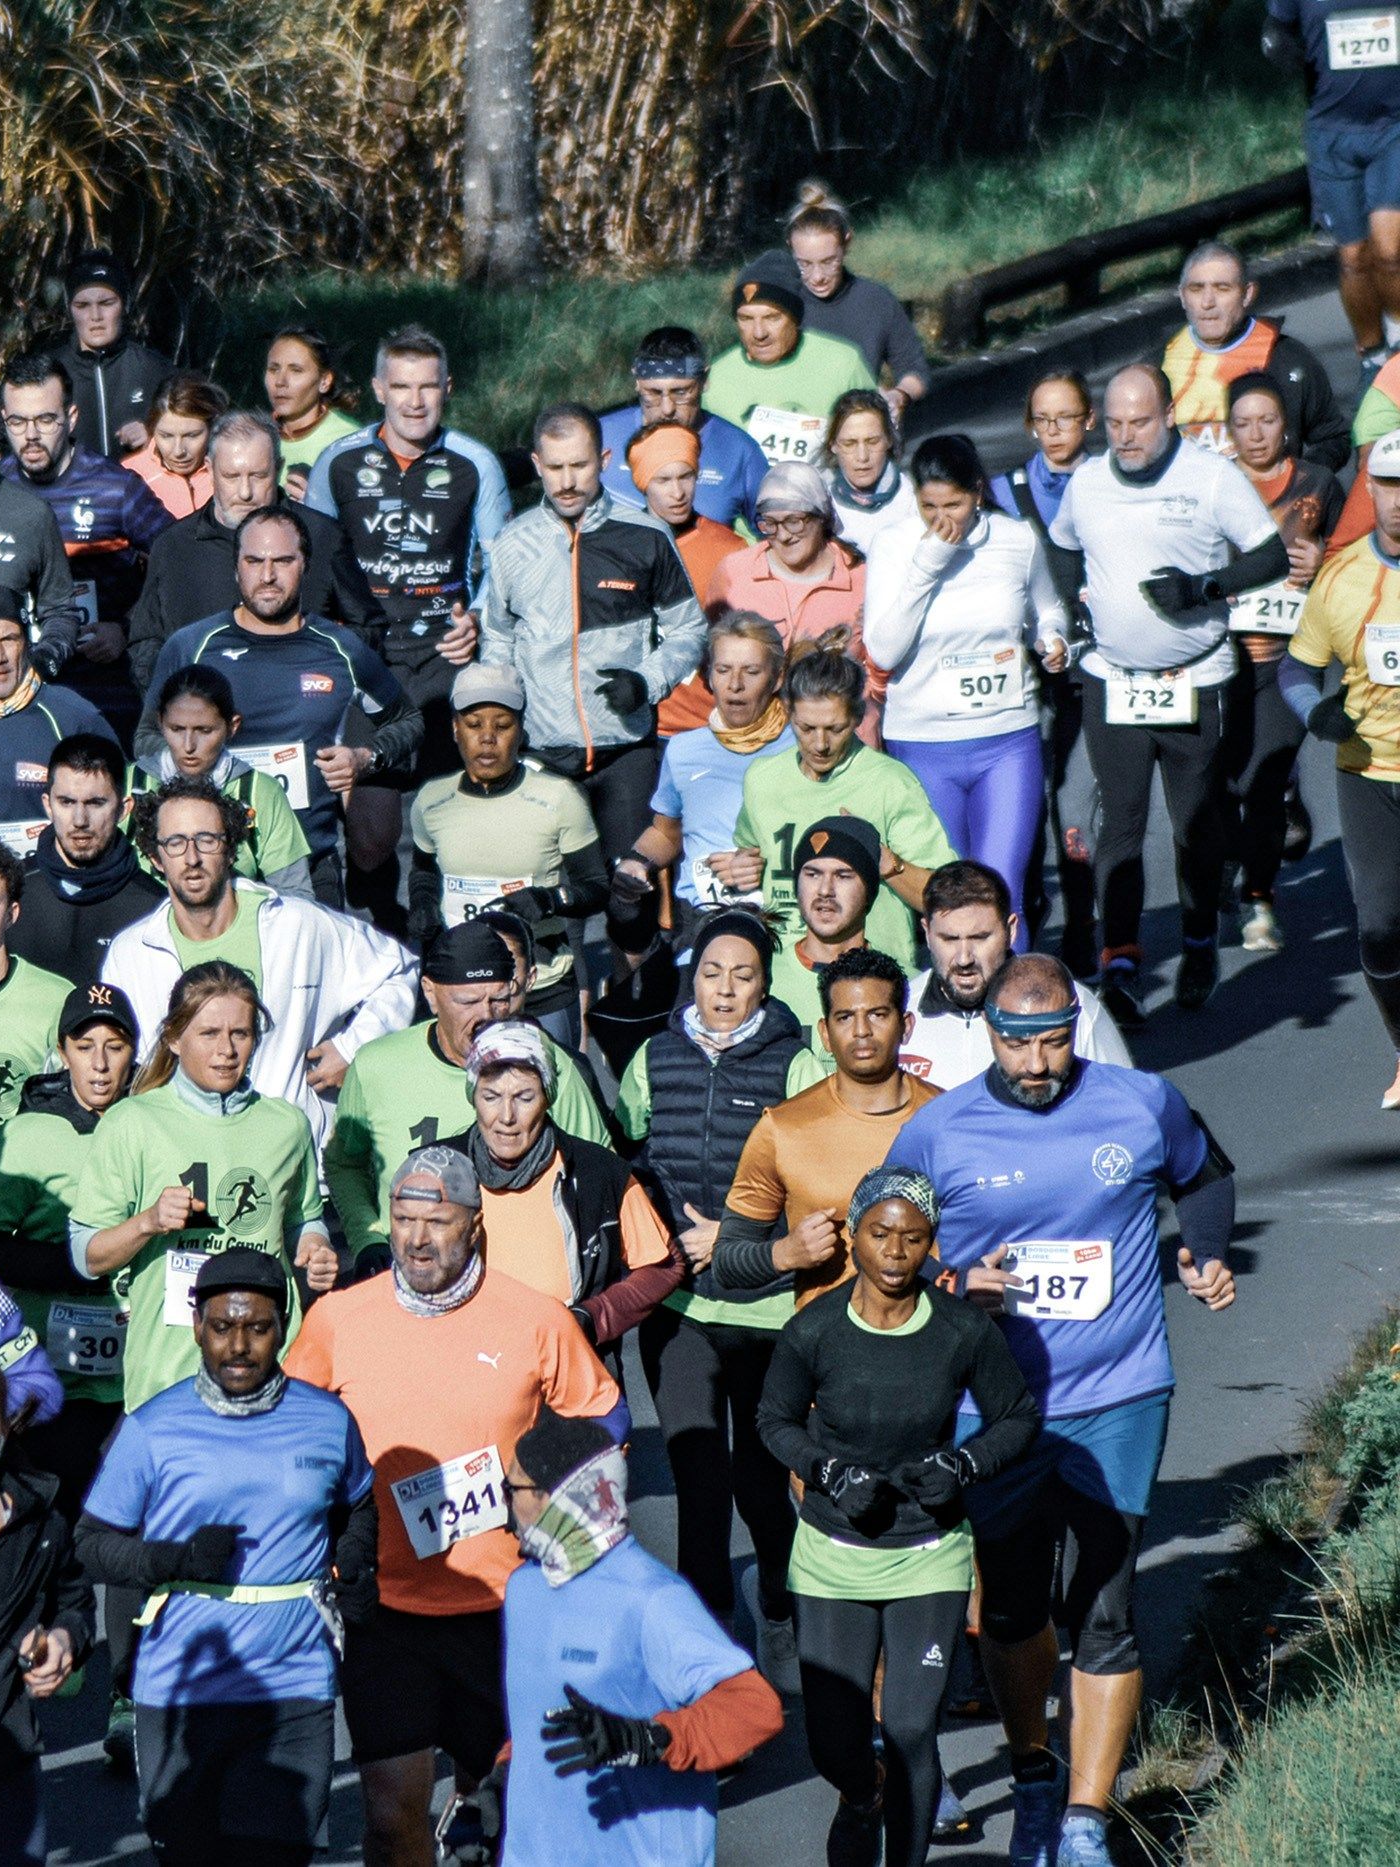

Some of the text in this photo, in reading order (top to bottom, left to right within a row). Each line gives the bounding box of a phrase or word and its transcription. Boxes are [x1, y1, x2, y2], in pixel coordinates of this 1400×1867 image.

[1339, 37, 1389, 56] 1270
[761, 434, 807, 457] 418
[421, 608, 453, 617] BERGERA
[302, 679, 332, 691] SNCF
[960, 673, 1007, 697] 507
[1125, 689, 1174, 708] 732
[19, 769, 48, 780] SNCF
[466, 968, 494, 979] odlo
[899, 1061, 931, 1075] NCF
[177, 1236, 199, 1250] km
[203, 1235, 222, 1250] du
[1025, 1274, 1089, 1300] 187
[78, 1336, 119, 1359] 30
[418, 1482, 498, 1534] 1341
